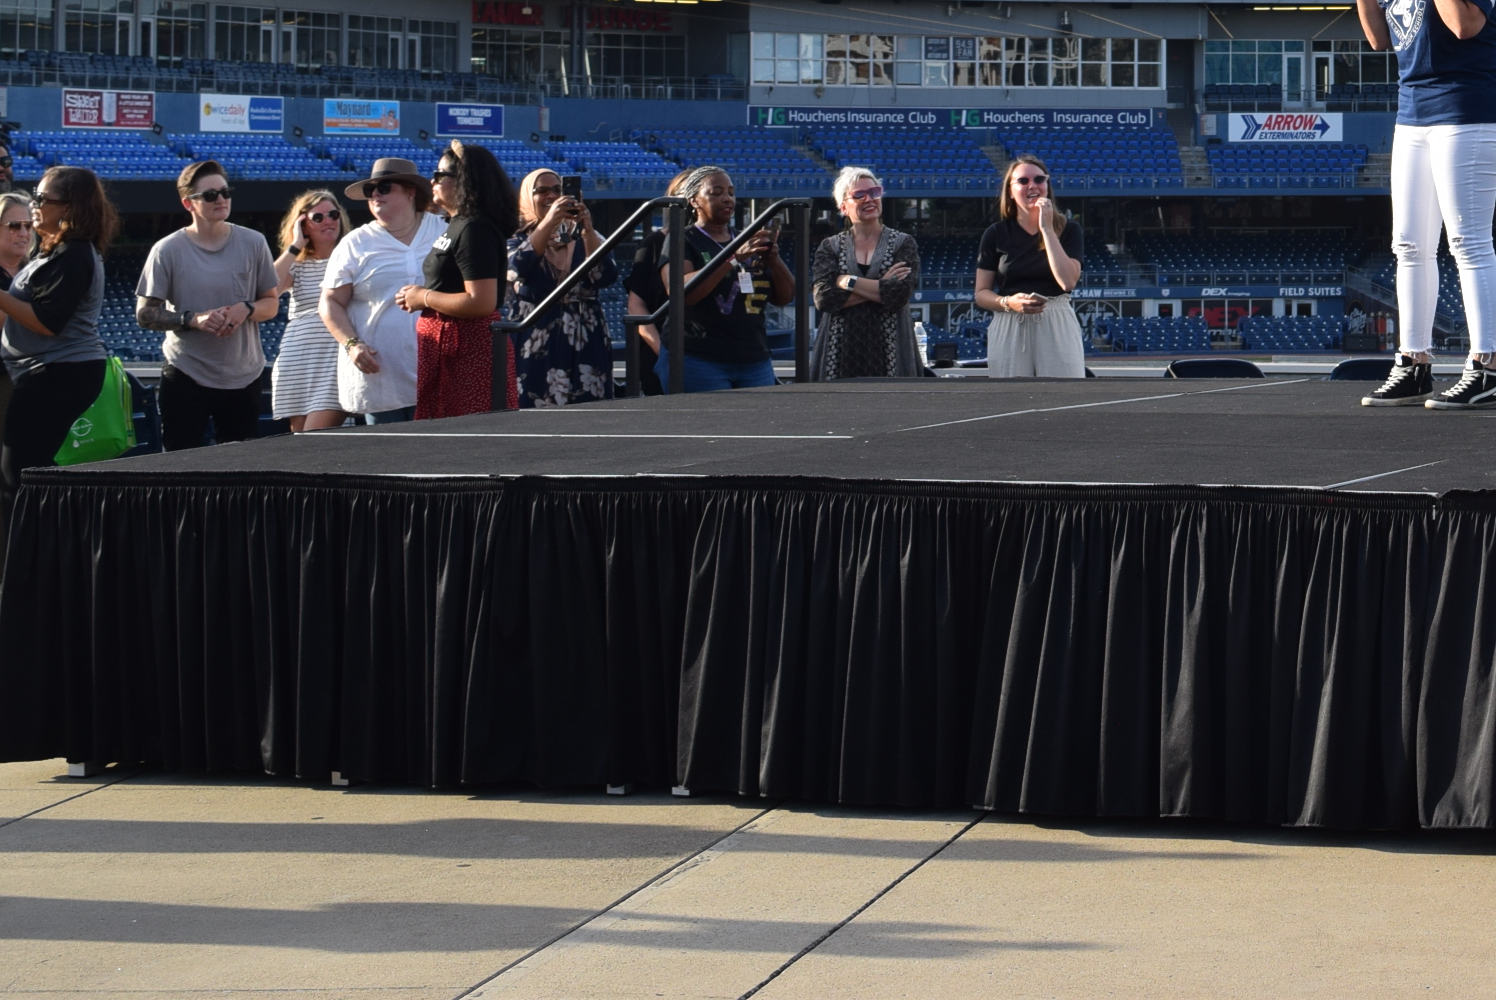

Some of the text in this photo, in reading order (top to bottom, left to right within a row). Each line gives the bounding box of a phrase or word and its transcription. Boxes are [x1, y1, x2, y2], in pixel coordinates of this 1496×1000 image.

[336, 101, 371, 117] Maynard
[789, 110, 846, 123] Houchens
[848, 111, 905, 123] Insurance
[908, 111, 936, 124] Club
[983, 111, 1045, 123] Houchens
[1053, 111, 1113, 124] Insurance
[1117, 112, 1146, 125] Club
[1261, 114, 1319, 131] ARROW
[1259, 131, 1317, 140] EXTERMINATORS
[1201, 287, 1229, 296] DEX
[1279, 287, 1342, 296] FIELD SUITES
